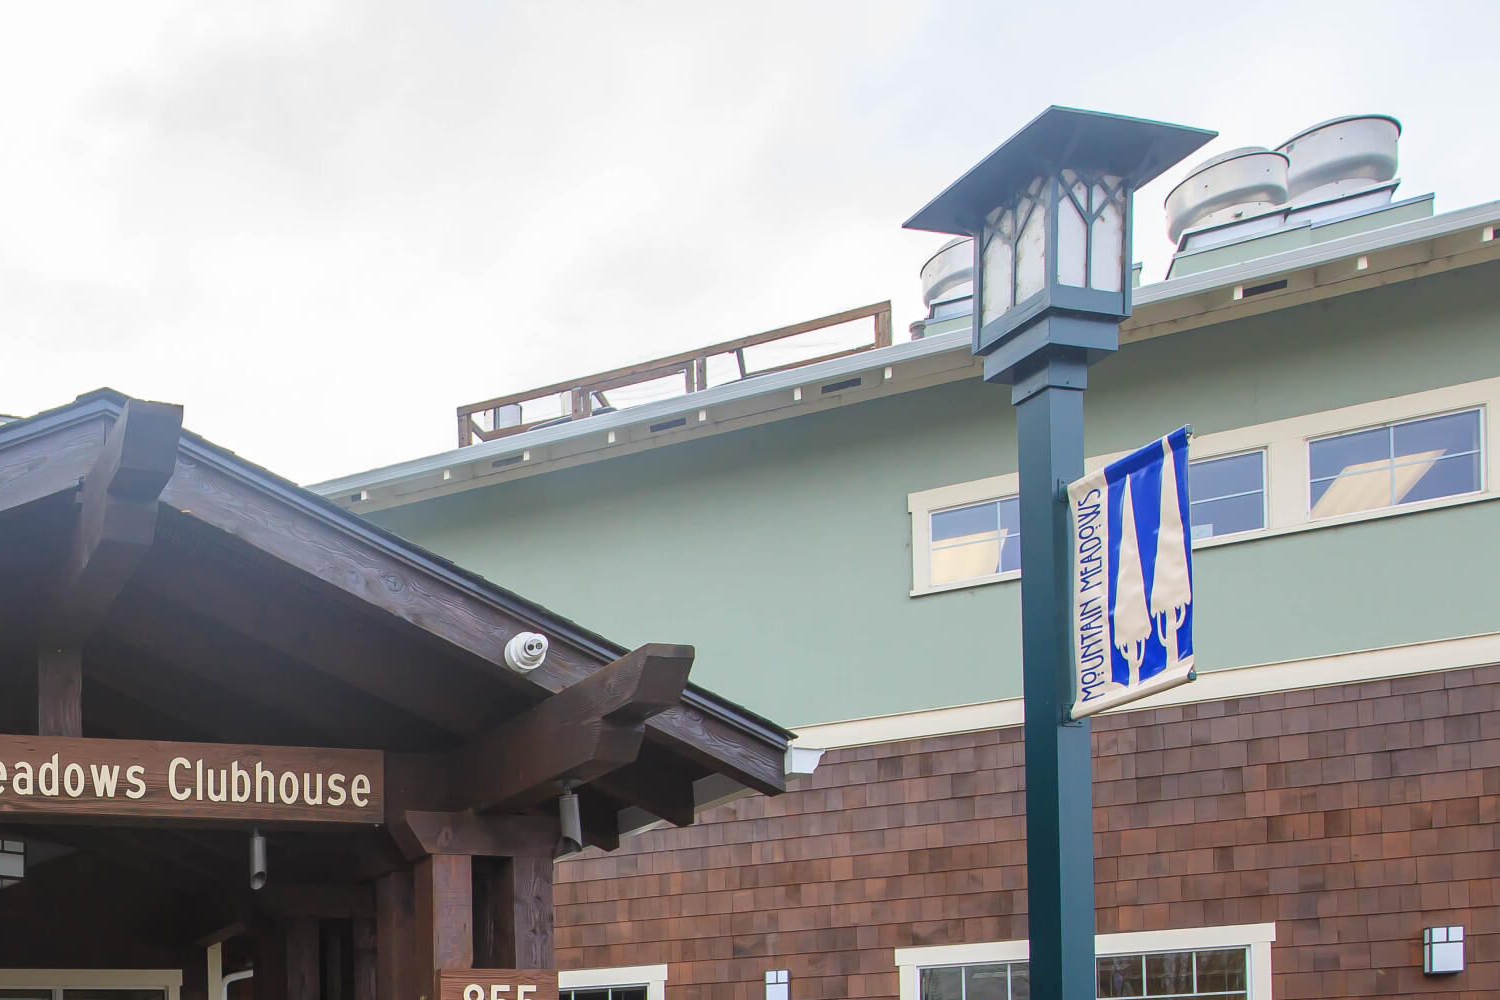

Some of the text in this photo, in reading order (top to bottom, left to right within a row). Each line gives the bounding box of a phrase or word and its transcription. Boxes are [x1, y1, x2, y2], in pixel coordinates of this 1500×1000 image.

[1077, 488, 1105, 703] MOUNTAIN MEADOWS
[168, 756, 372, 808] Clubhouse
